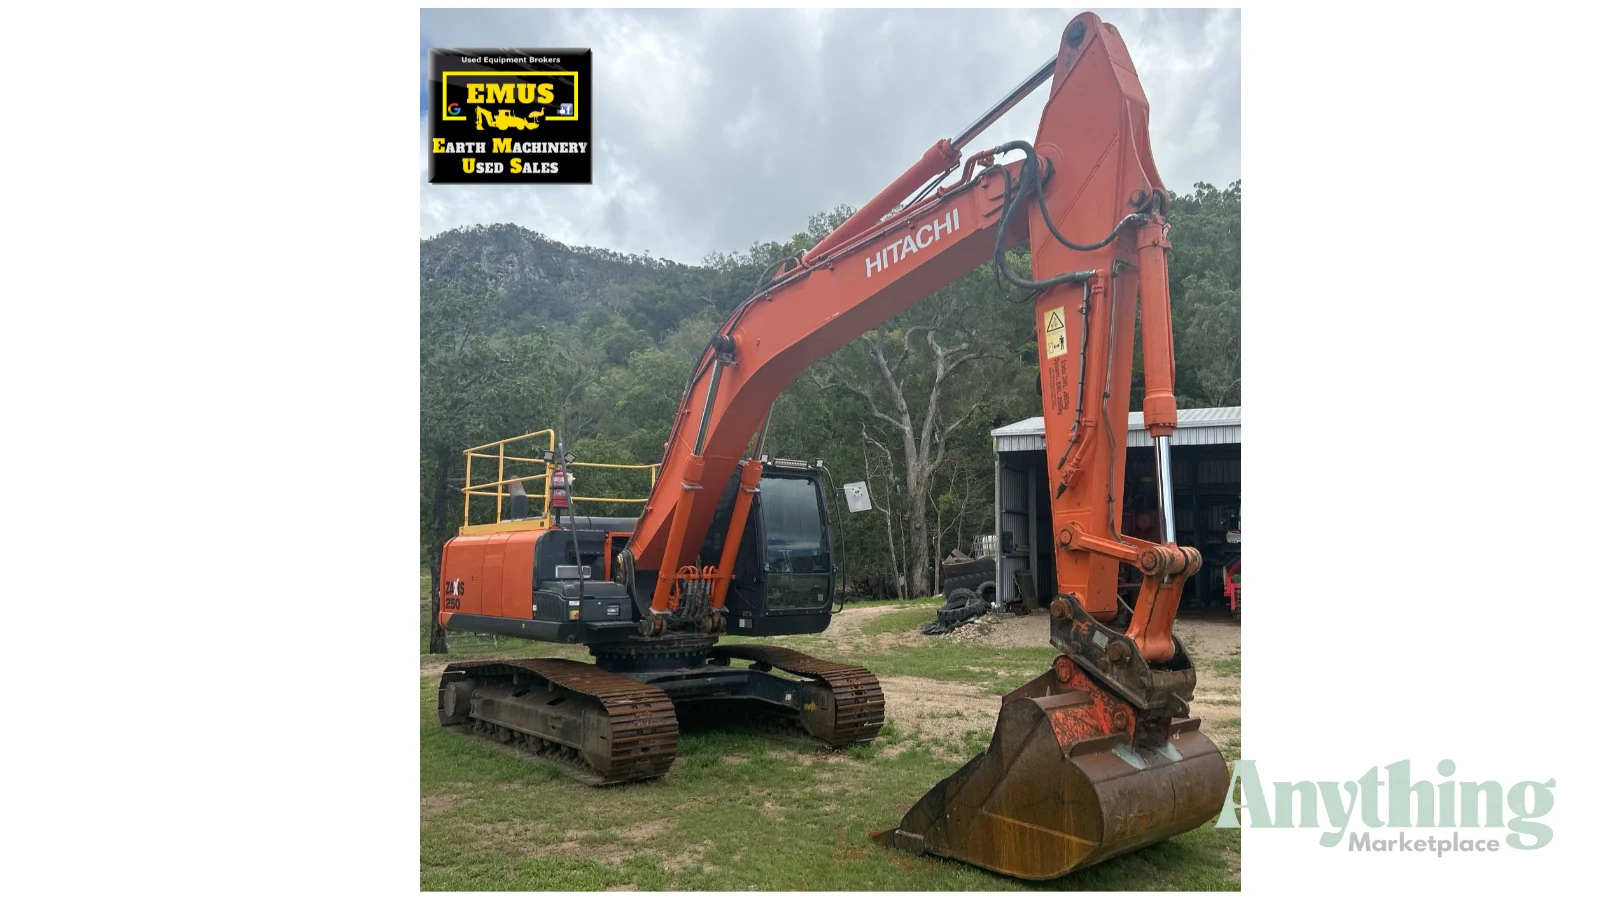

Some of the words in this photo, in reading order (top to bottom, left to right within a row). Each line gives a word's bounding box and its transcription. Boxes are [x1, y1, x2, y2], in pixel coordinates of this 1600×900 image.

[865, 207, 960, 278] HITACHI
[445, 577, 465, 596] ZAXIS
[445, 598, 460, 610] 250
